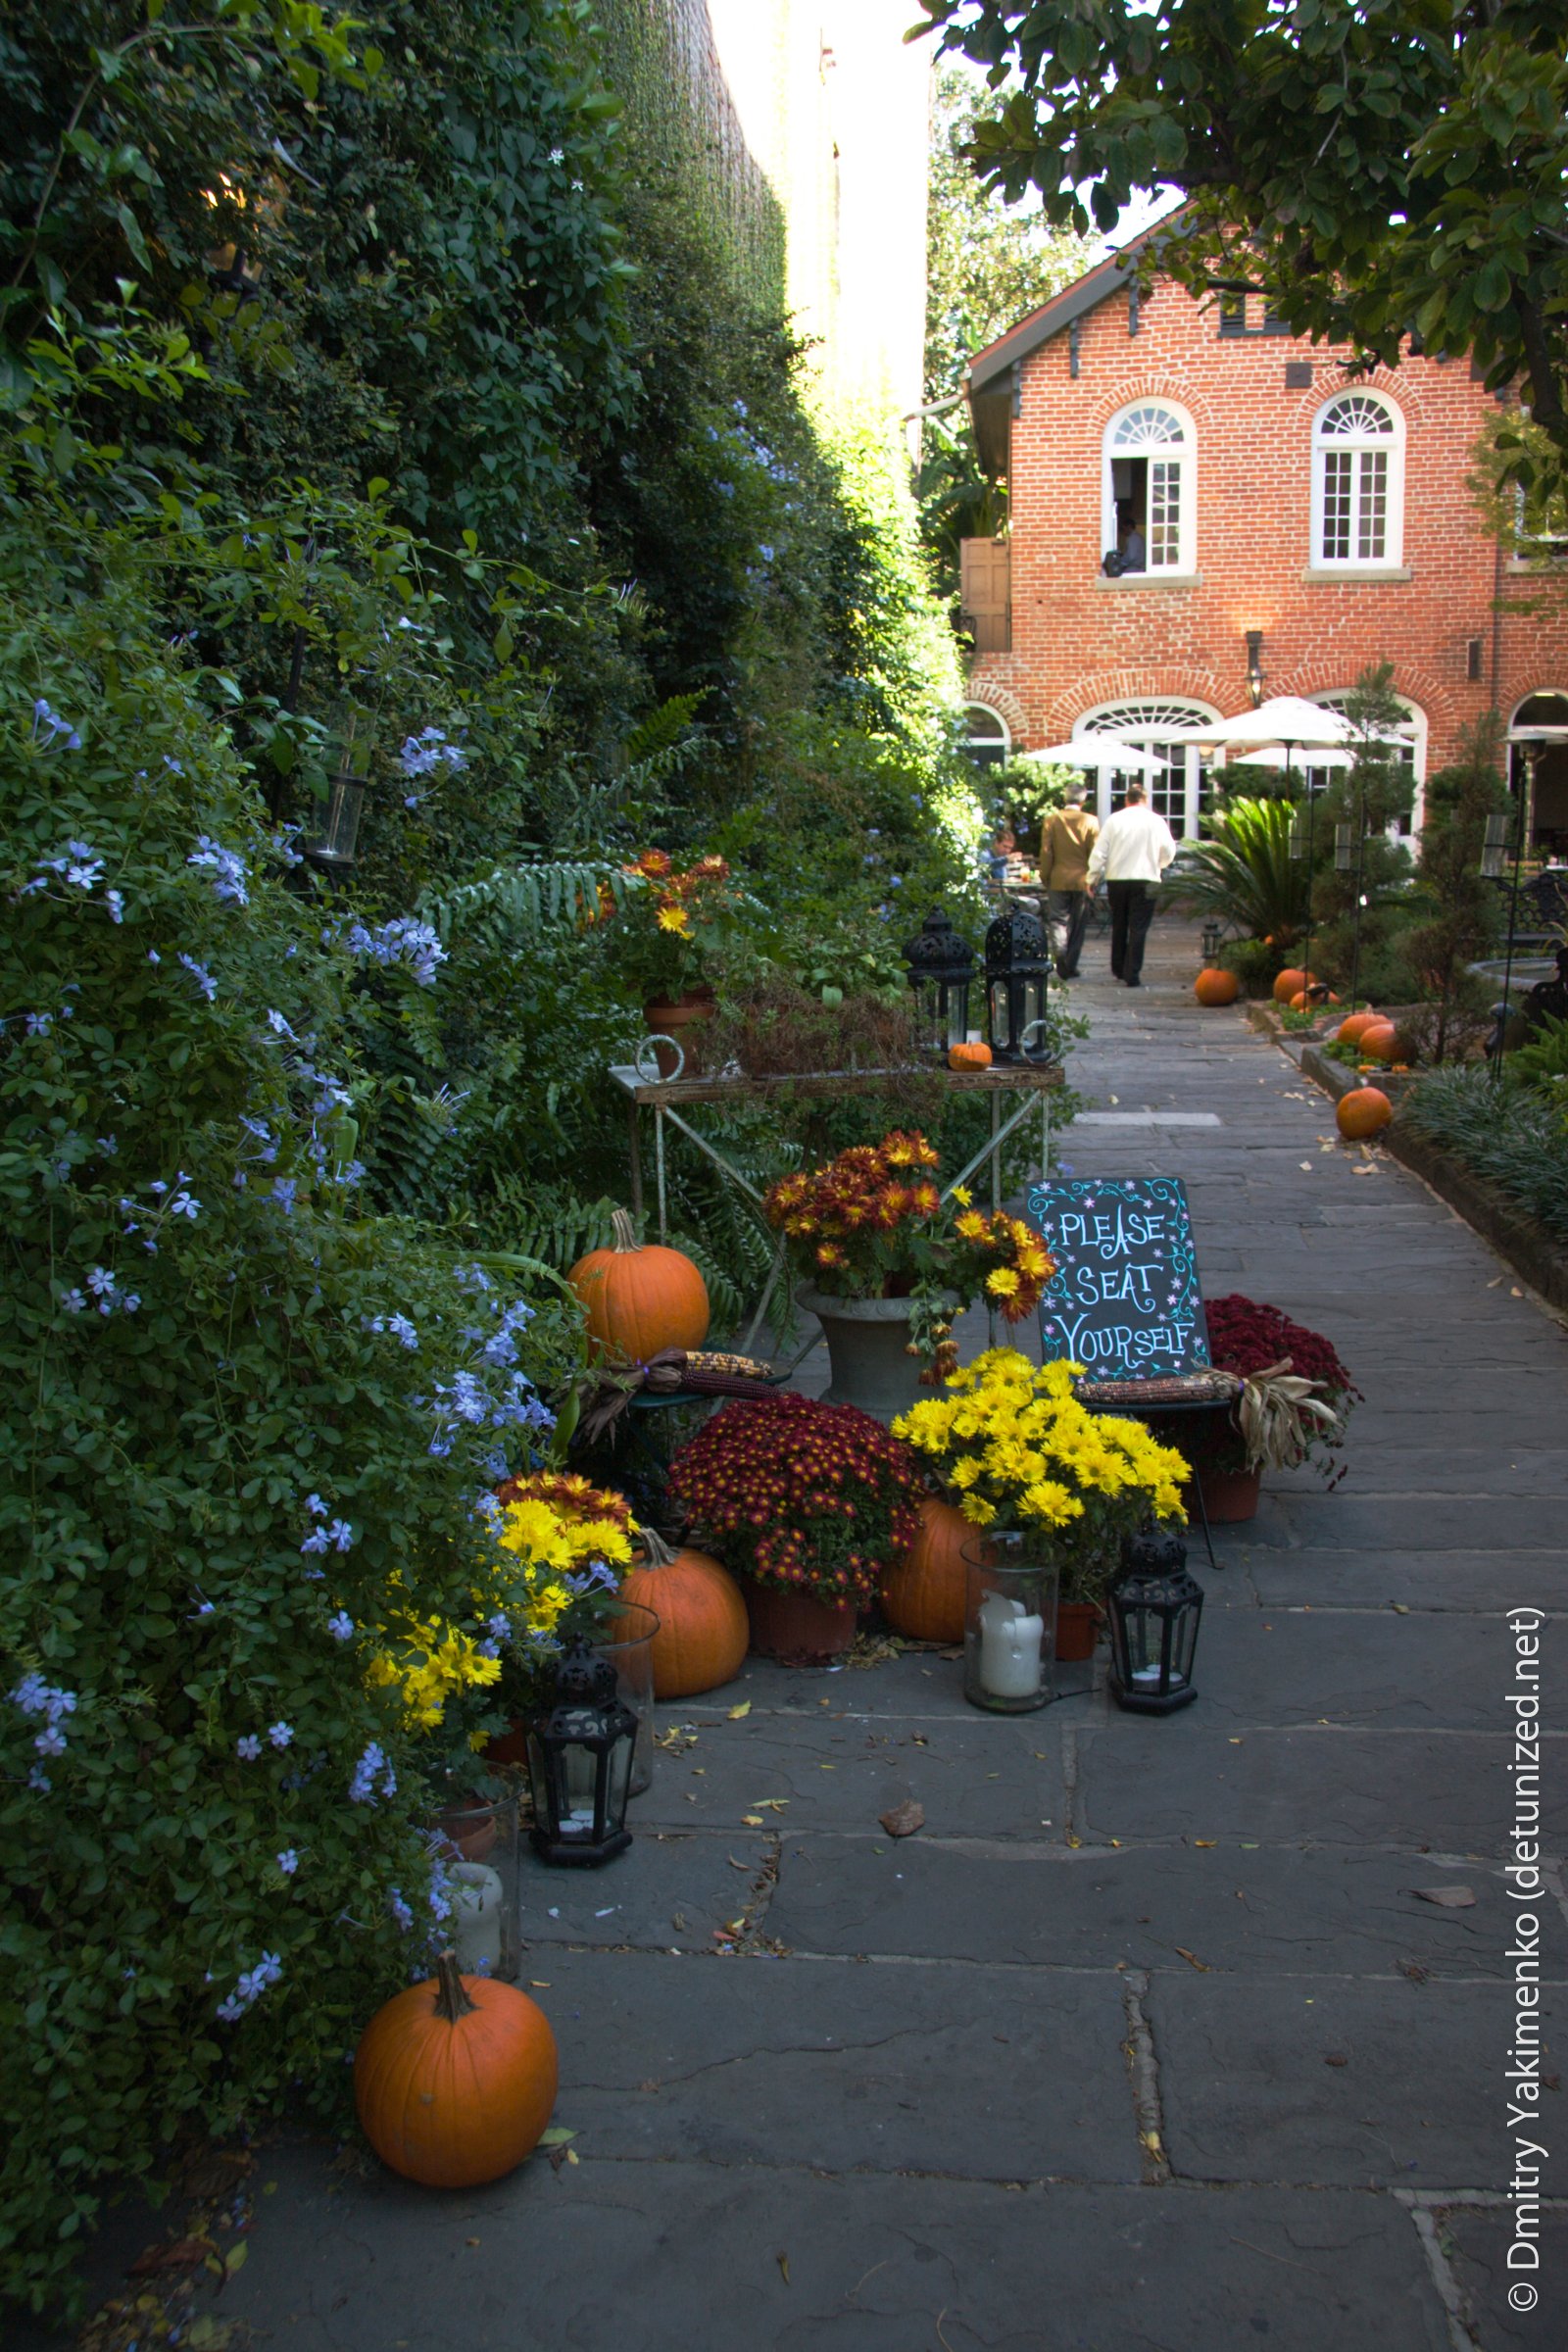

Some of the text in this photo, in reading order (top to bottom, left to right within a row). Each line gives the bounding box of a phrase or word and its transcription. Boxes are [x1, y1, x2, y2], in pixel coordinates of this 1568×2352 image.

[1058, 1203, 1165, 1260] PLEASE
[1075, 1262, 1164, 1313] SEAT
[1052, 1312, 1196, 1369] YOURSELF
